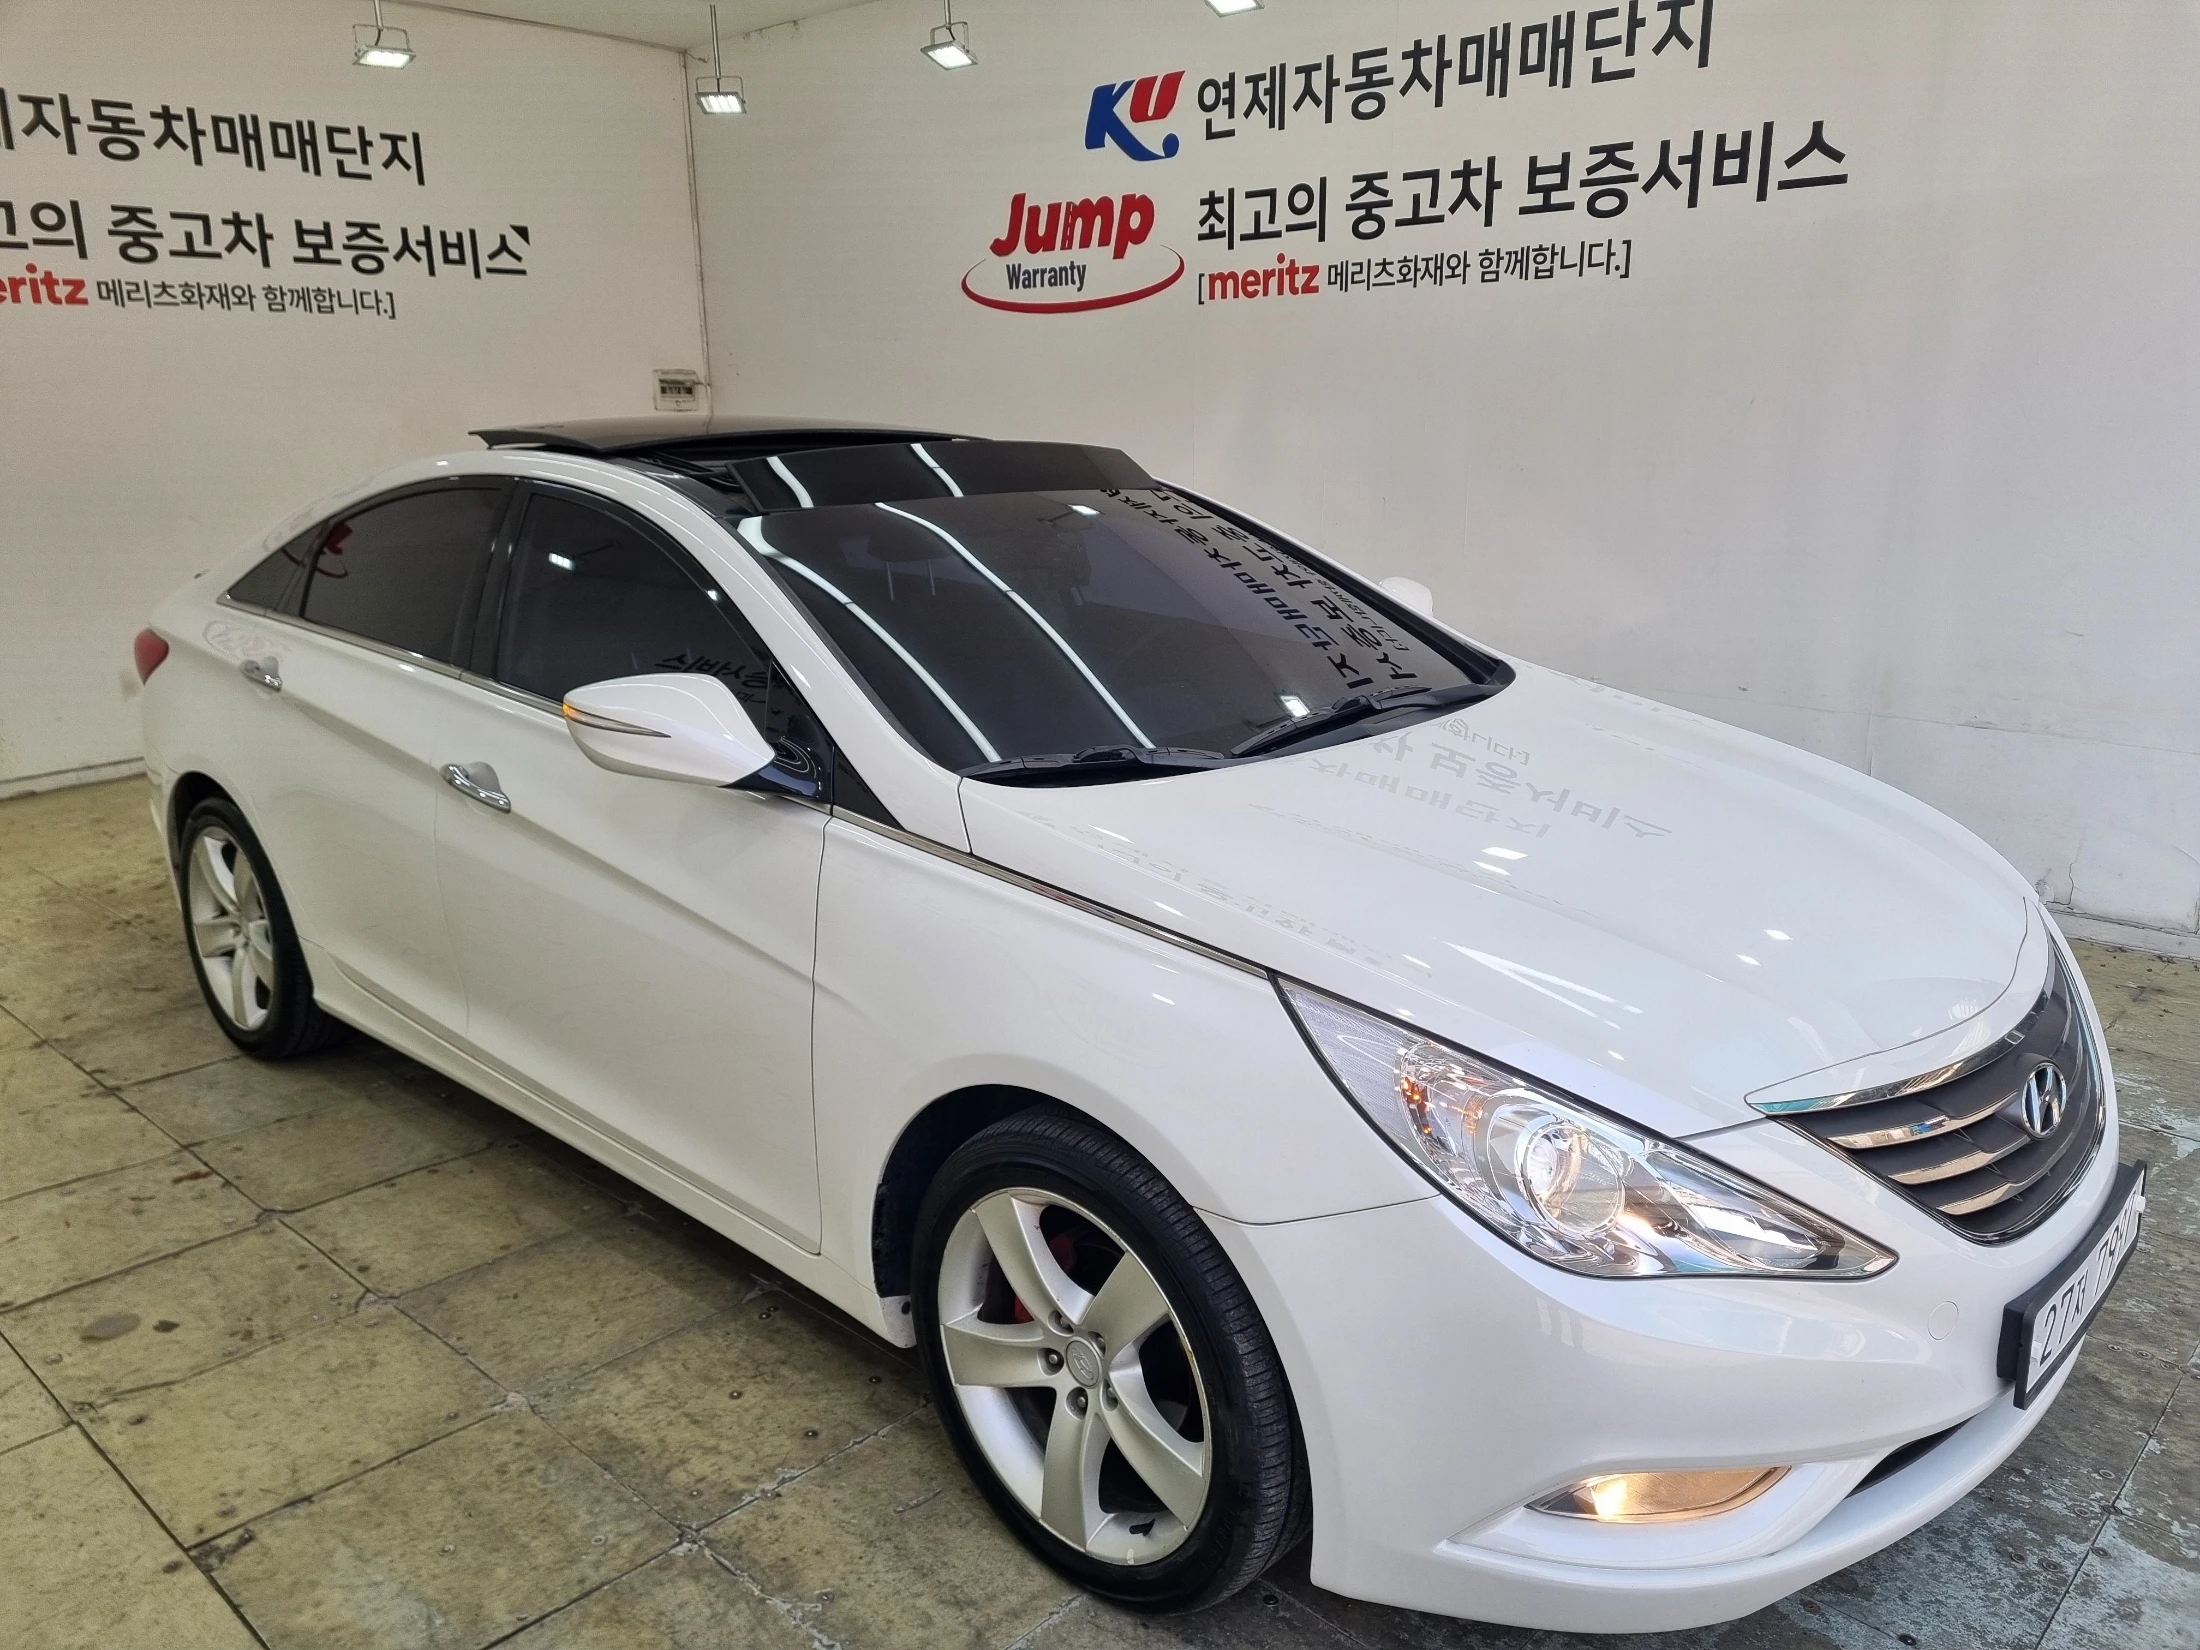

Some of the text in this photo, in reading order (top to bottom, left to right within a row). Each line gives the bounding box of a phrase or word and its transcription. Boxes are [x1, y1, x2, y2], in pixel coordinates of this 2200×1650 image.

[1197, 0, 1714, 141] 연제자동차매매단지
[1197, 120, 1849, 251] 최고의 중고차 보증서비스
[107, 203, 274, 269] 중고차
[292, 219, 528, 279] 보증서비스
[989, 192, 1155, 260] Jump
[96, 278, 256, 311] 메리츠화재와
[1005, 260, 1087, 292] Warranty
[1327, 250, 1471, 294] 메리츠화재와
[1478, 238, 1632, 284] 함께합니다.]
